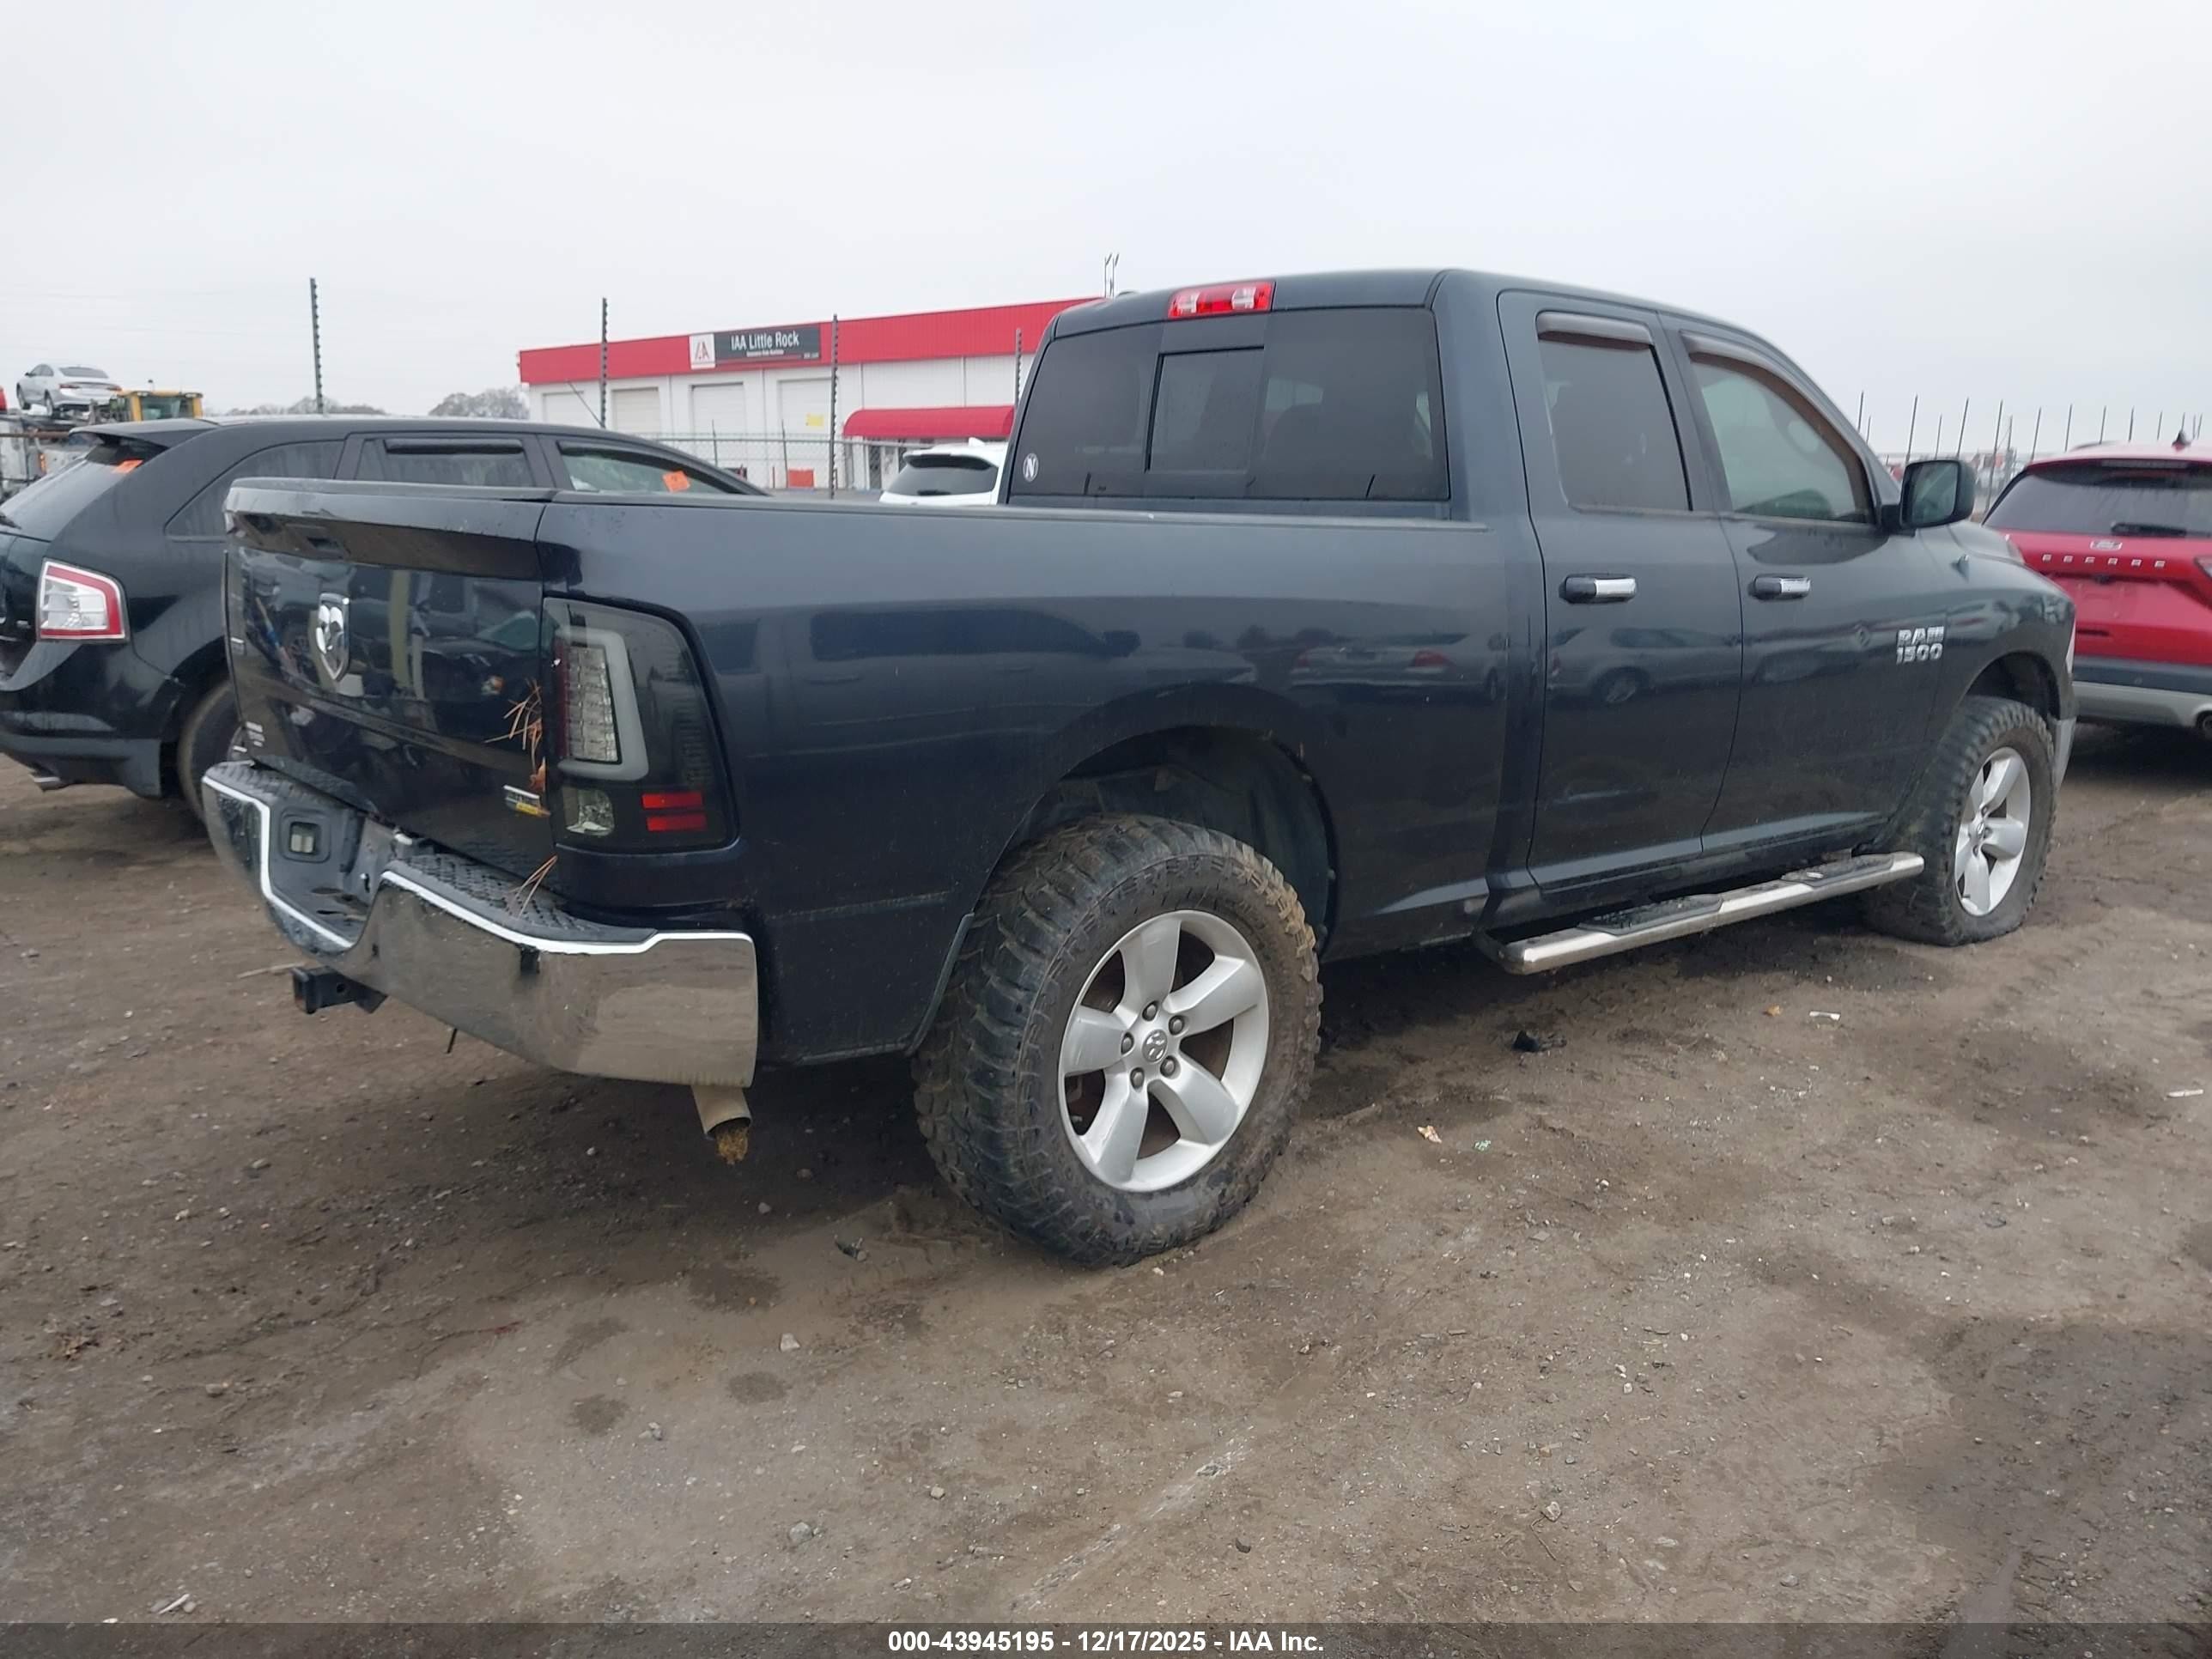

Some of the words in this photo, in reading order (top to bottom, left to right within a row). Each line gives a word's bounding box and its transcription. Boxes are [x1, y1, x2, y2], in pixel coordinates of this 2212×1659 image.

[731, 336, 746, 350] IAA
[749, 332, 772, 349] Little
[775, 331, 799, 347] Rock
[1897, 626, 1944, 646] RAM
[1896, 643, 1943, 665] 1500
